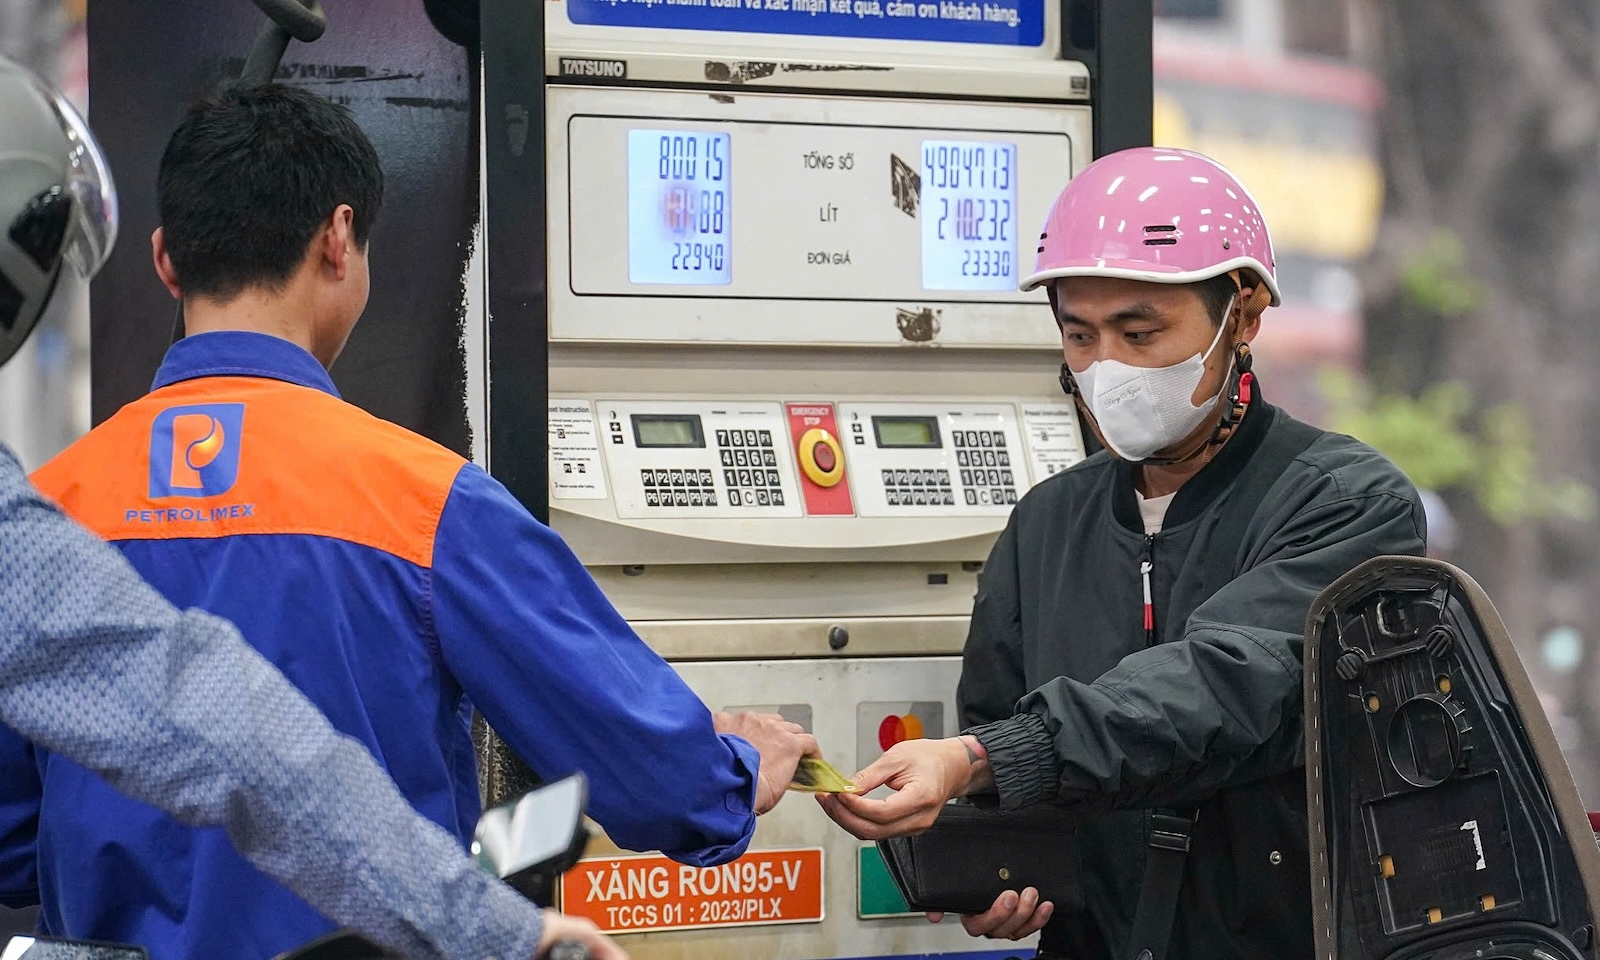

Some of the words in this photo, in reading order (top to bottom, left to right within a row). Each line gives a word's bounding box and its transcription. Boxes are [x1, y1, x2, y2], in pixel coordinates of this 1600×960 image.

[940, 1, 981, 20] khách
[983, 3, 1021, 27] hàng.
[562, 60, 625, 77] TATSUNO
[660, 136, 723, 181] 80015
[839, 152, 854, 170] SỐ
[925, 147, 1010, 190] 4904713
[819, 202, 839, 222] LÍT
[672, 243, 724, 271] 22940
[832, 249, 852, 264] GIÁ
[962, 250, 1010, 277] 23330
[718, 432, 726, 445] 7
[733, 432, 742, 445] 8
[746, 432, 756, 445] 9
[954, 432, 962, 446] 7
[968, 432, 977, 446] 8
[982, 432, 991, 446] 9
[723, 451, 731, 465] 4
[737, 451, 746, 465] 5
[751, 451, 760, 465] 6
[960, 451, 968, 466] 4
[972, 451, 981, 466] 5
[986, 451, 995, 466] 6
[643, 472, 654, 483] P1
[657, 472, 669, 483] P2
[671, 472, 683, 483] P3
[686, 472, 697, 483] P4
[700, 472, 712, 483] P5
[727, 471, 735, 485] 1
[740, 471, 750, 485] 2
[755, 471, 764, 485] 3
[963, 471, 971, 485] 1
[976, 471, 985, 485] 2
[990, 471, 999, 485] 3
[646, 493, 658, 503] P6
[661, 493, 672, 503] P7
[675, 493, 686, 503] P8
[690, 493, 701, 503] P9
[703, 493, 717, 503] P10
[730, 491, 740, 504] 0
[745, 491, 753, 504] C
[966, 490, 976, 504] 0
[980, 490, 988, 504] C
[125, 502, 255, 522] PETROLIMEX
[585, 862, 670, 902] XĂNG
[678, 860, 802, 897] RON95-V
[606, 905, 658, 927] TCCS
[663, 903, 683, 924] 01
[700, 898, 782, 922] 2023/PLX
